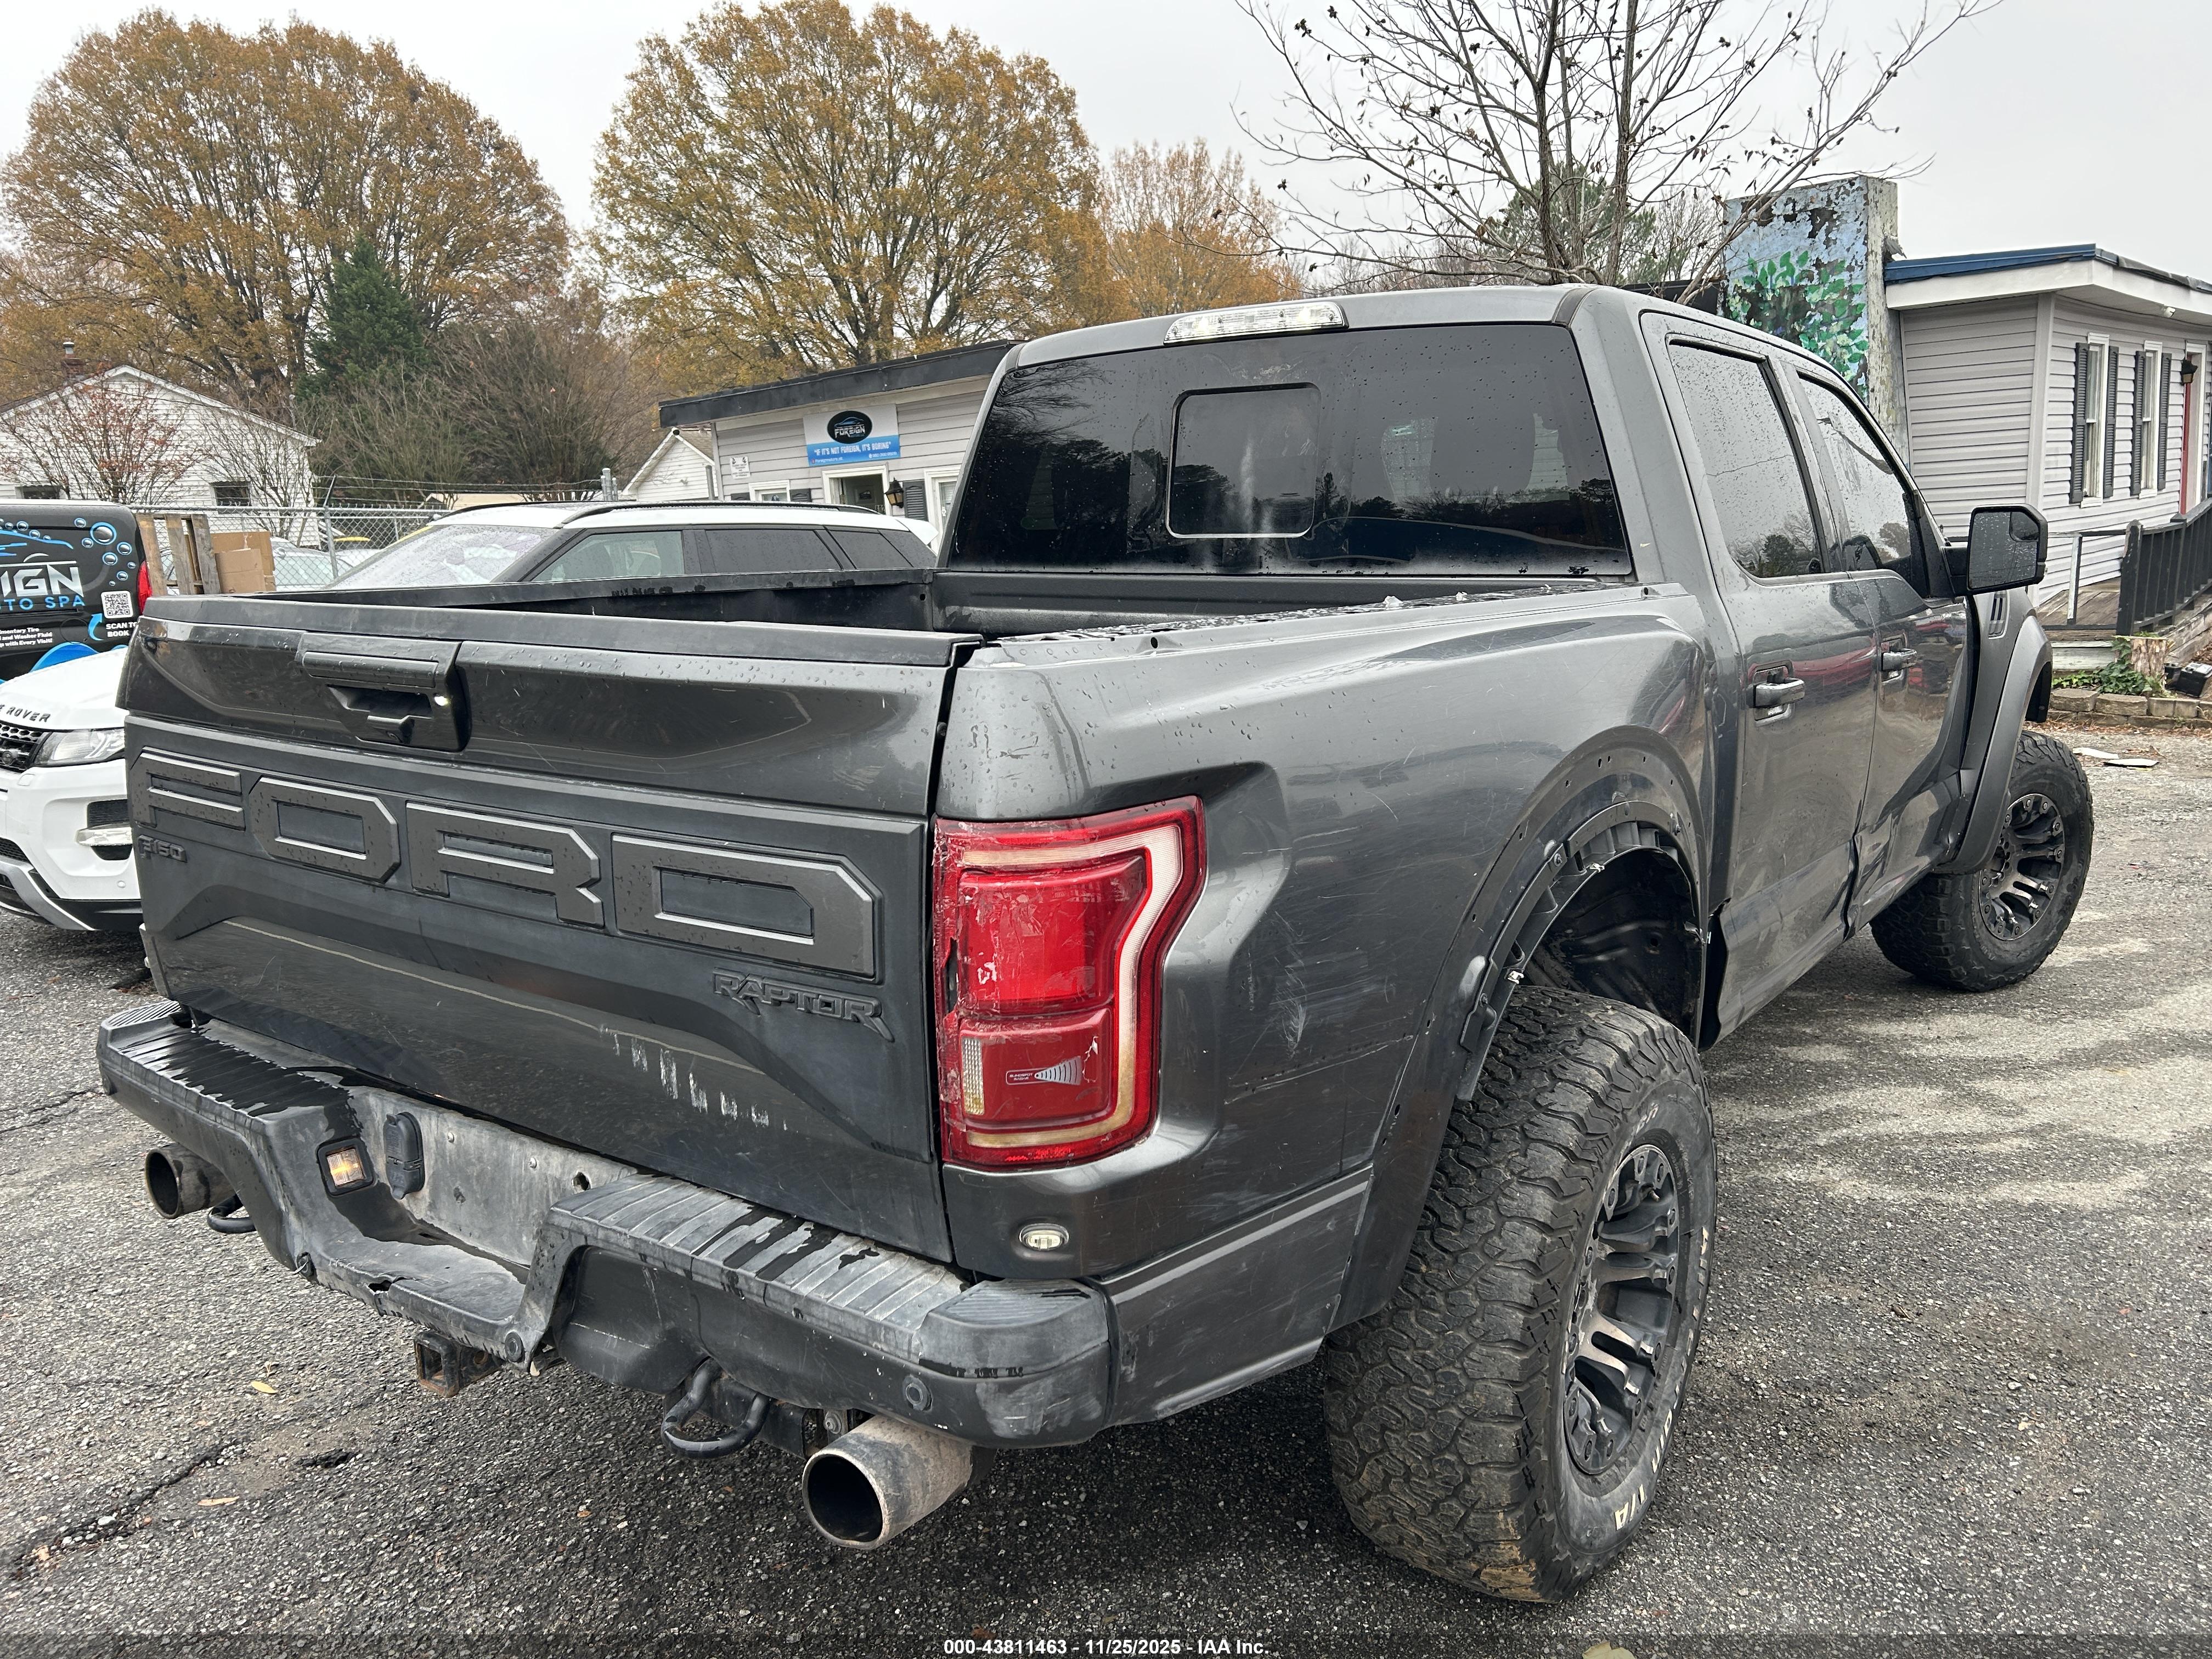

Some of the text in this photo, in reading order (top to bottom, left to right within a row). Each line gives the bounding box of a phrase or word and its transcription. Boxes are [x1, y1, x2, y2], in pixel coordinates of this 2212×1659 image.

[834, 425, 866, 438] FOREIGN
[840, 445, 861, 453] FOREIGN,
[44, 595, 86, 609] SPA
[6, 706, 51, 723] ROVER
[130, 748, 881, 983] FORD
[714, 968, 895, 1042] RAPTOR
